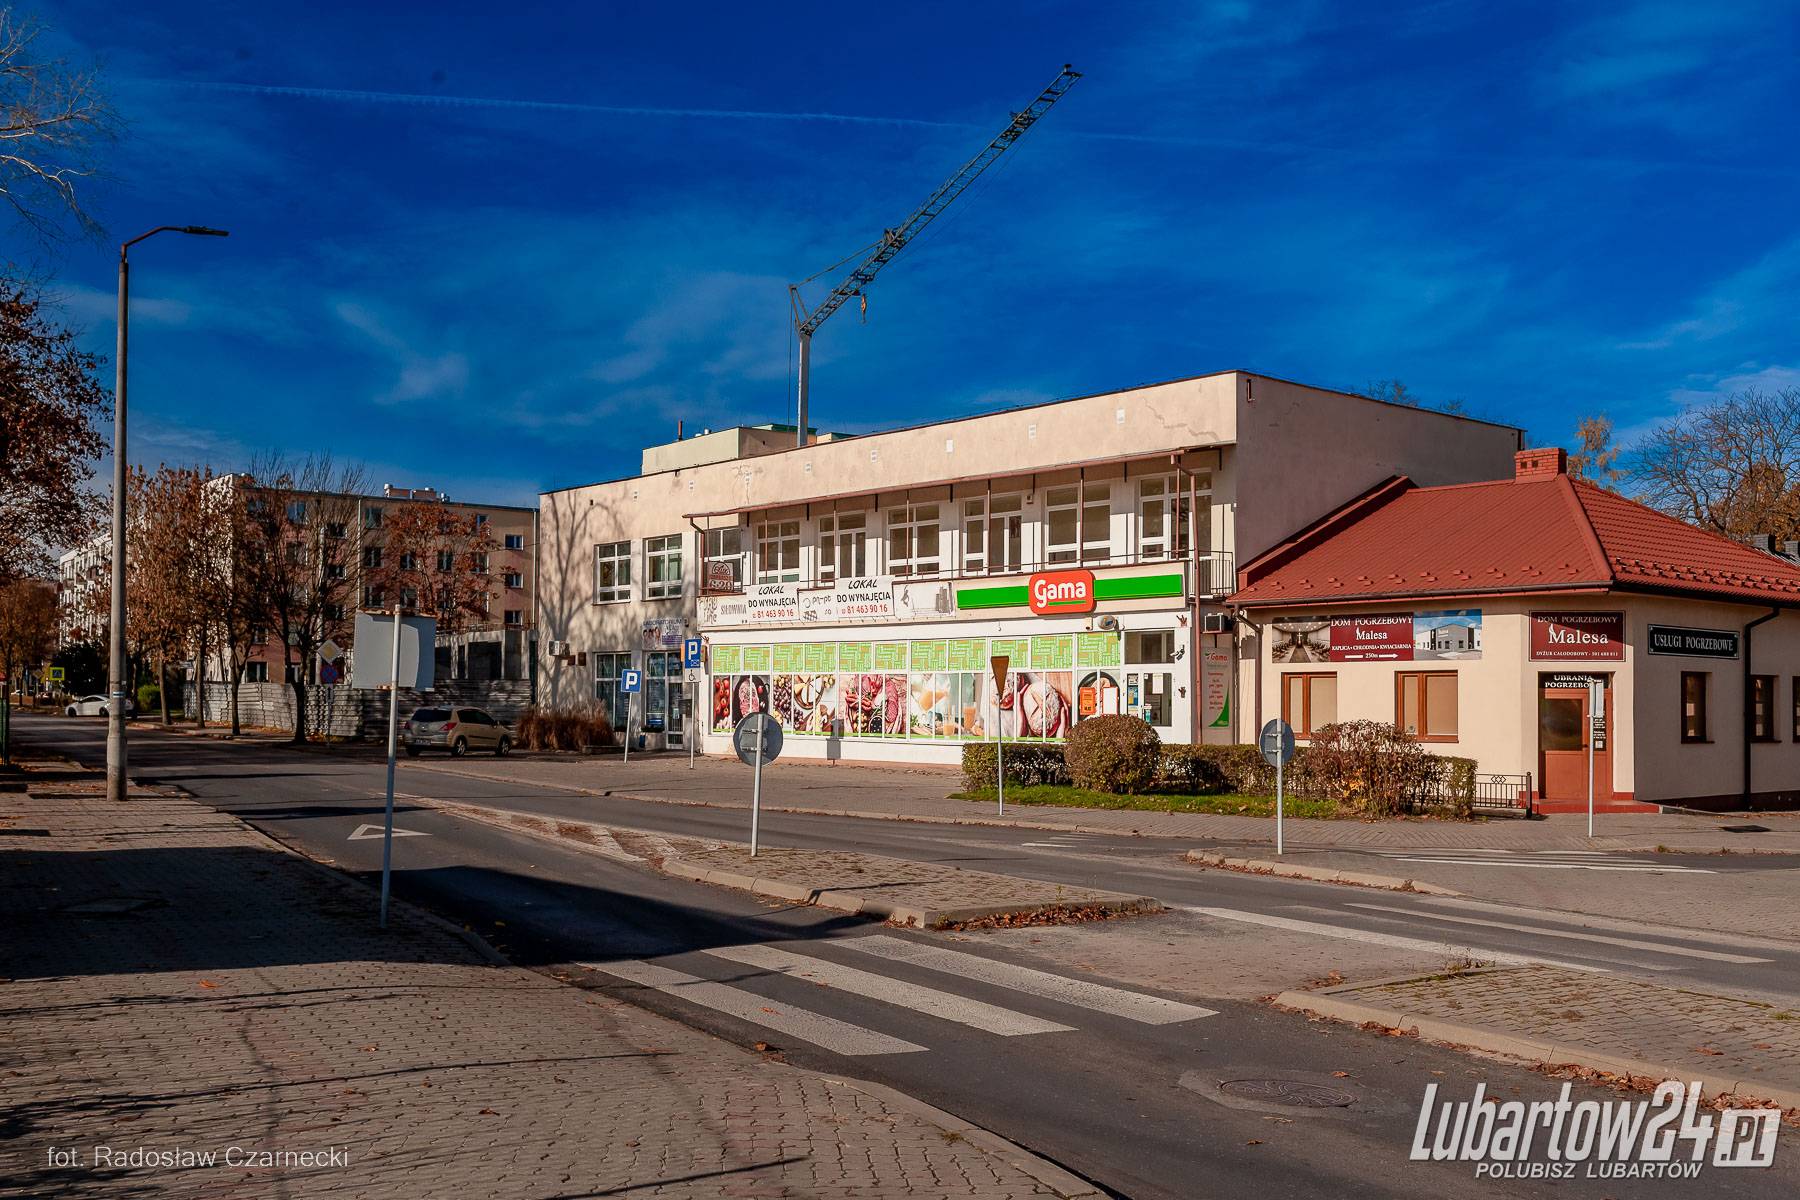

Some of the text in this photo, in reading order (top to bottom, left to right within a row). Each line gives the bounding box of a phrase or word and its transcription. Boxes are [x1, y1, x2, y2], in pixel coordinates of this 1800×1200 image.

[849, 578, 878, 589] LOKAL
[758, 585, 784, 595] LOKAL
[1034, 579, 1087, 609] Gama
[748, 597, 797, 608] DO WYNAJĘCIA
[836, 591, 892, 603] DO WYNAJĘCIA
[757, 608, 794, 619] 81 463 90 16
[847, 603, 888, 613] 81 463 90 16
[1331, 615, 1413, 627] DOM POGRZEBOWY
[1356, 627, 1388, 641] Malesa
[1548, 623, 1609, 644] Malesa
[1654, 634, 1734, 651] USŁUGI POGRZEBOWE
[688, 641, 698, 661] P
[625, 672, 638, 690] P
